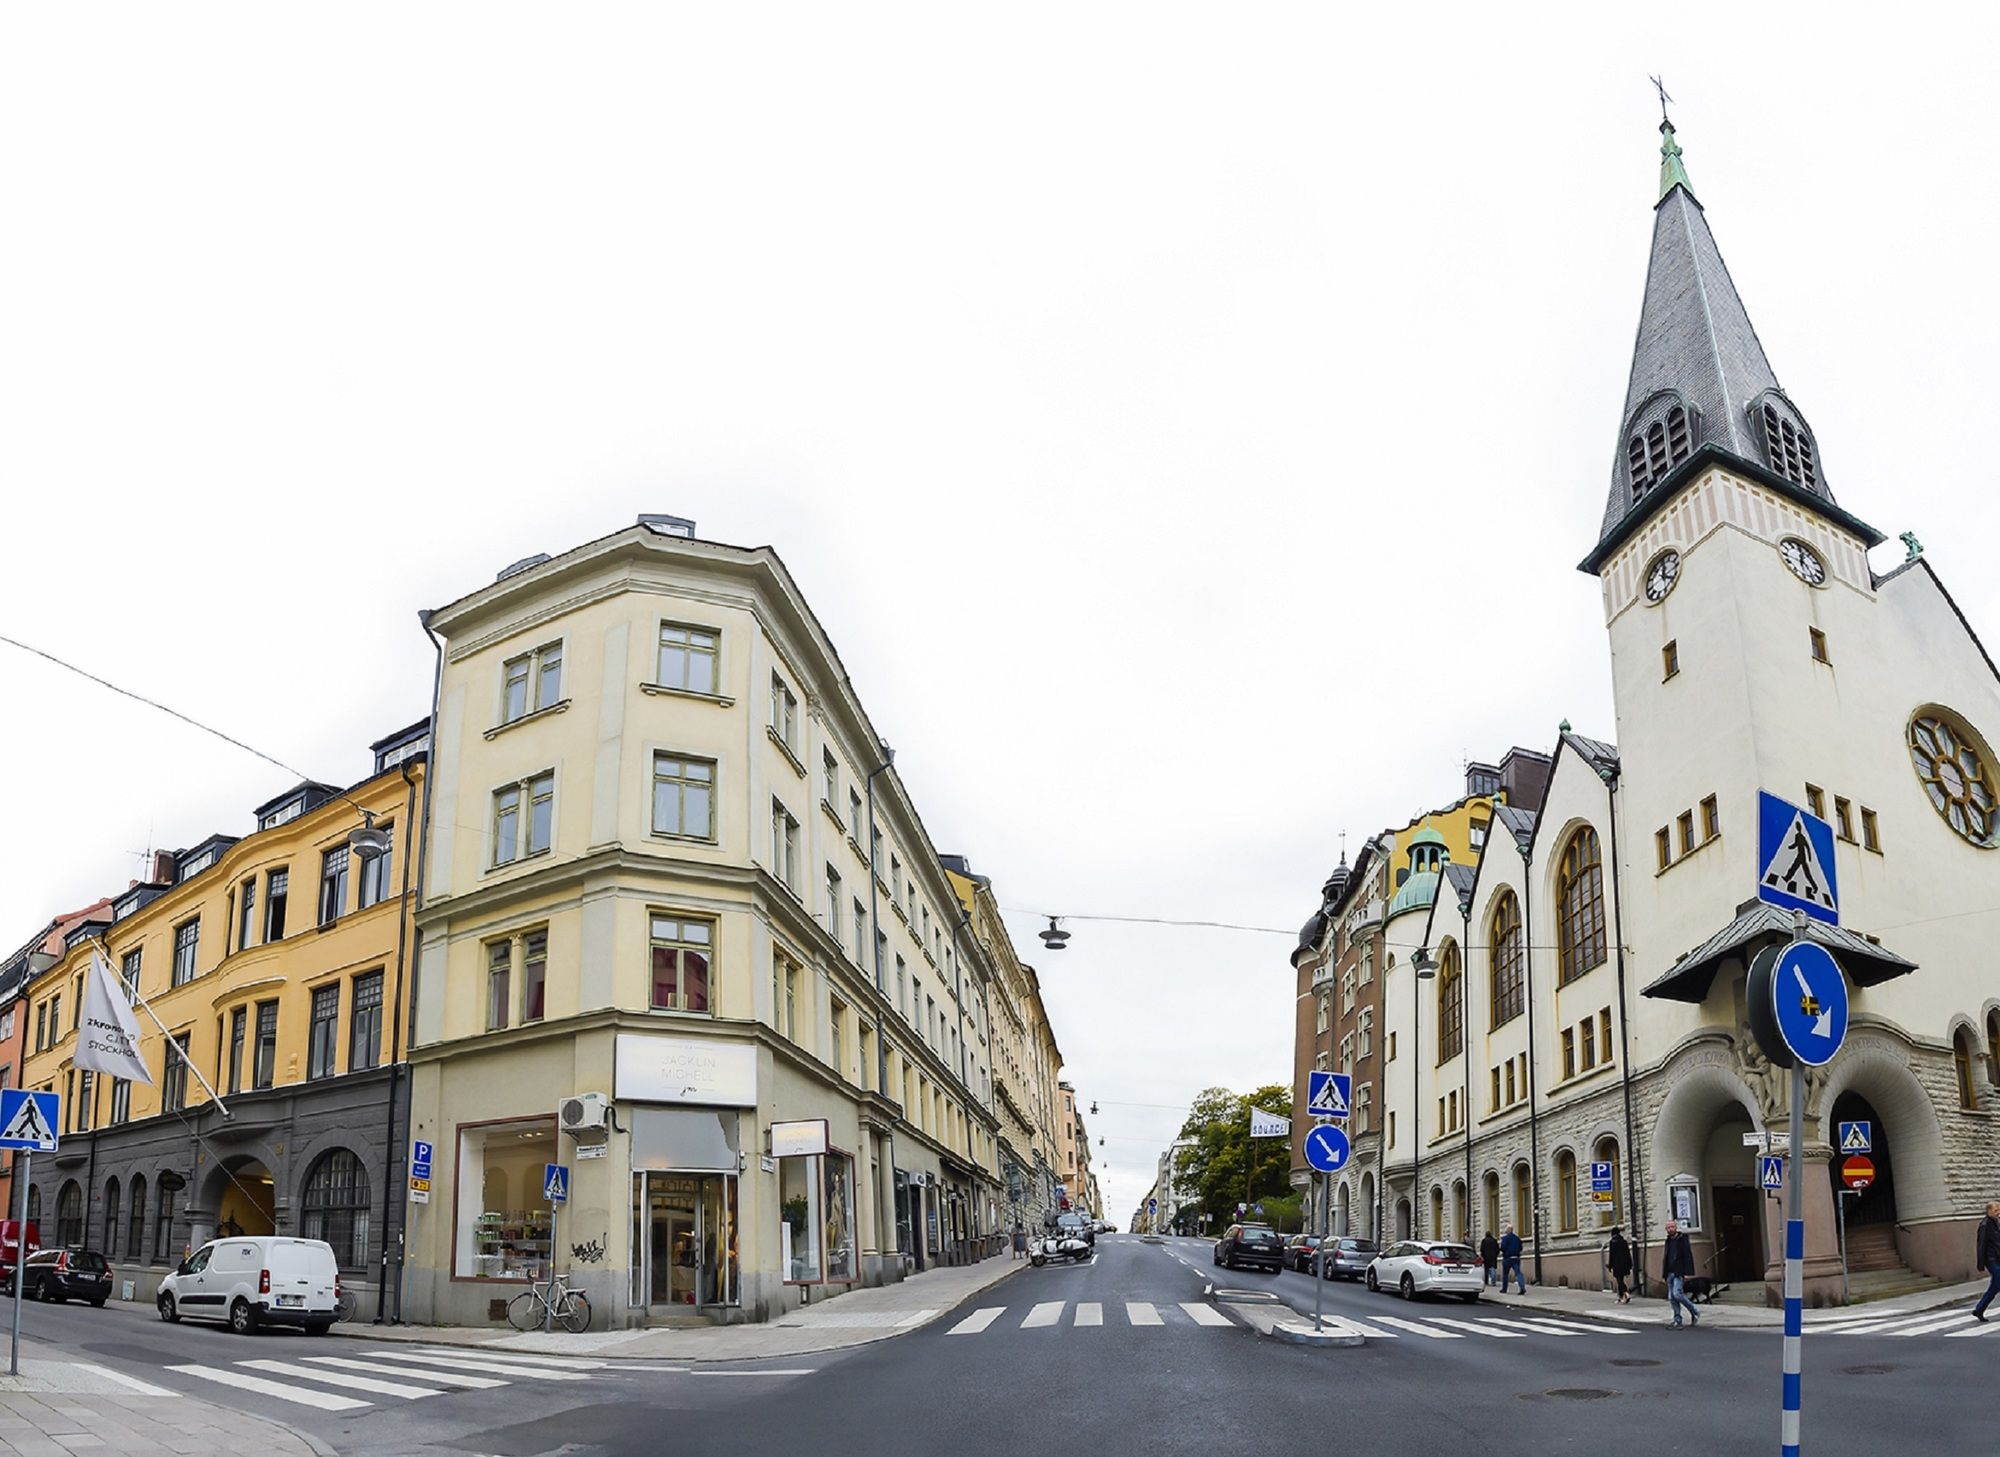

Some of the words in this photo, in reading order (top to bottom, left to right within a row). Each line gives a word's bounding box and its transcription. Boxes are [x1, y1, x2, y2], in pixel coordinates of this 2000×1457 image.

[88, 1040, 138, 1058] STOCKHOL
[661, 1054, 716, 1068] JACKLIN
[418, 1144, 429, 1160] P
[1597, 1164, 1607, 1177] P
